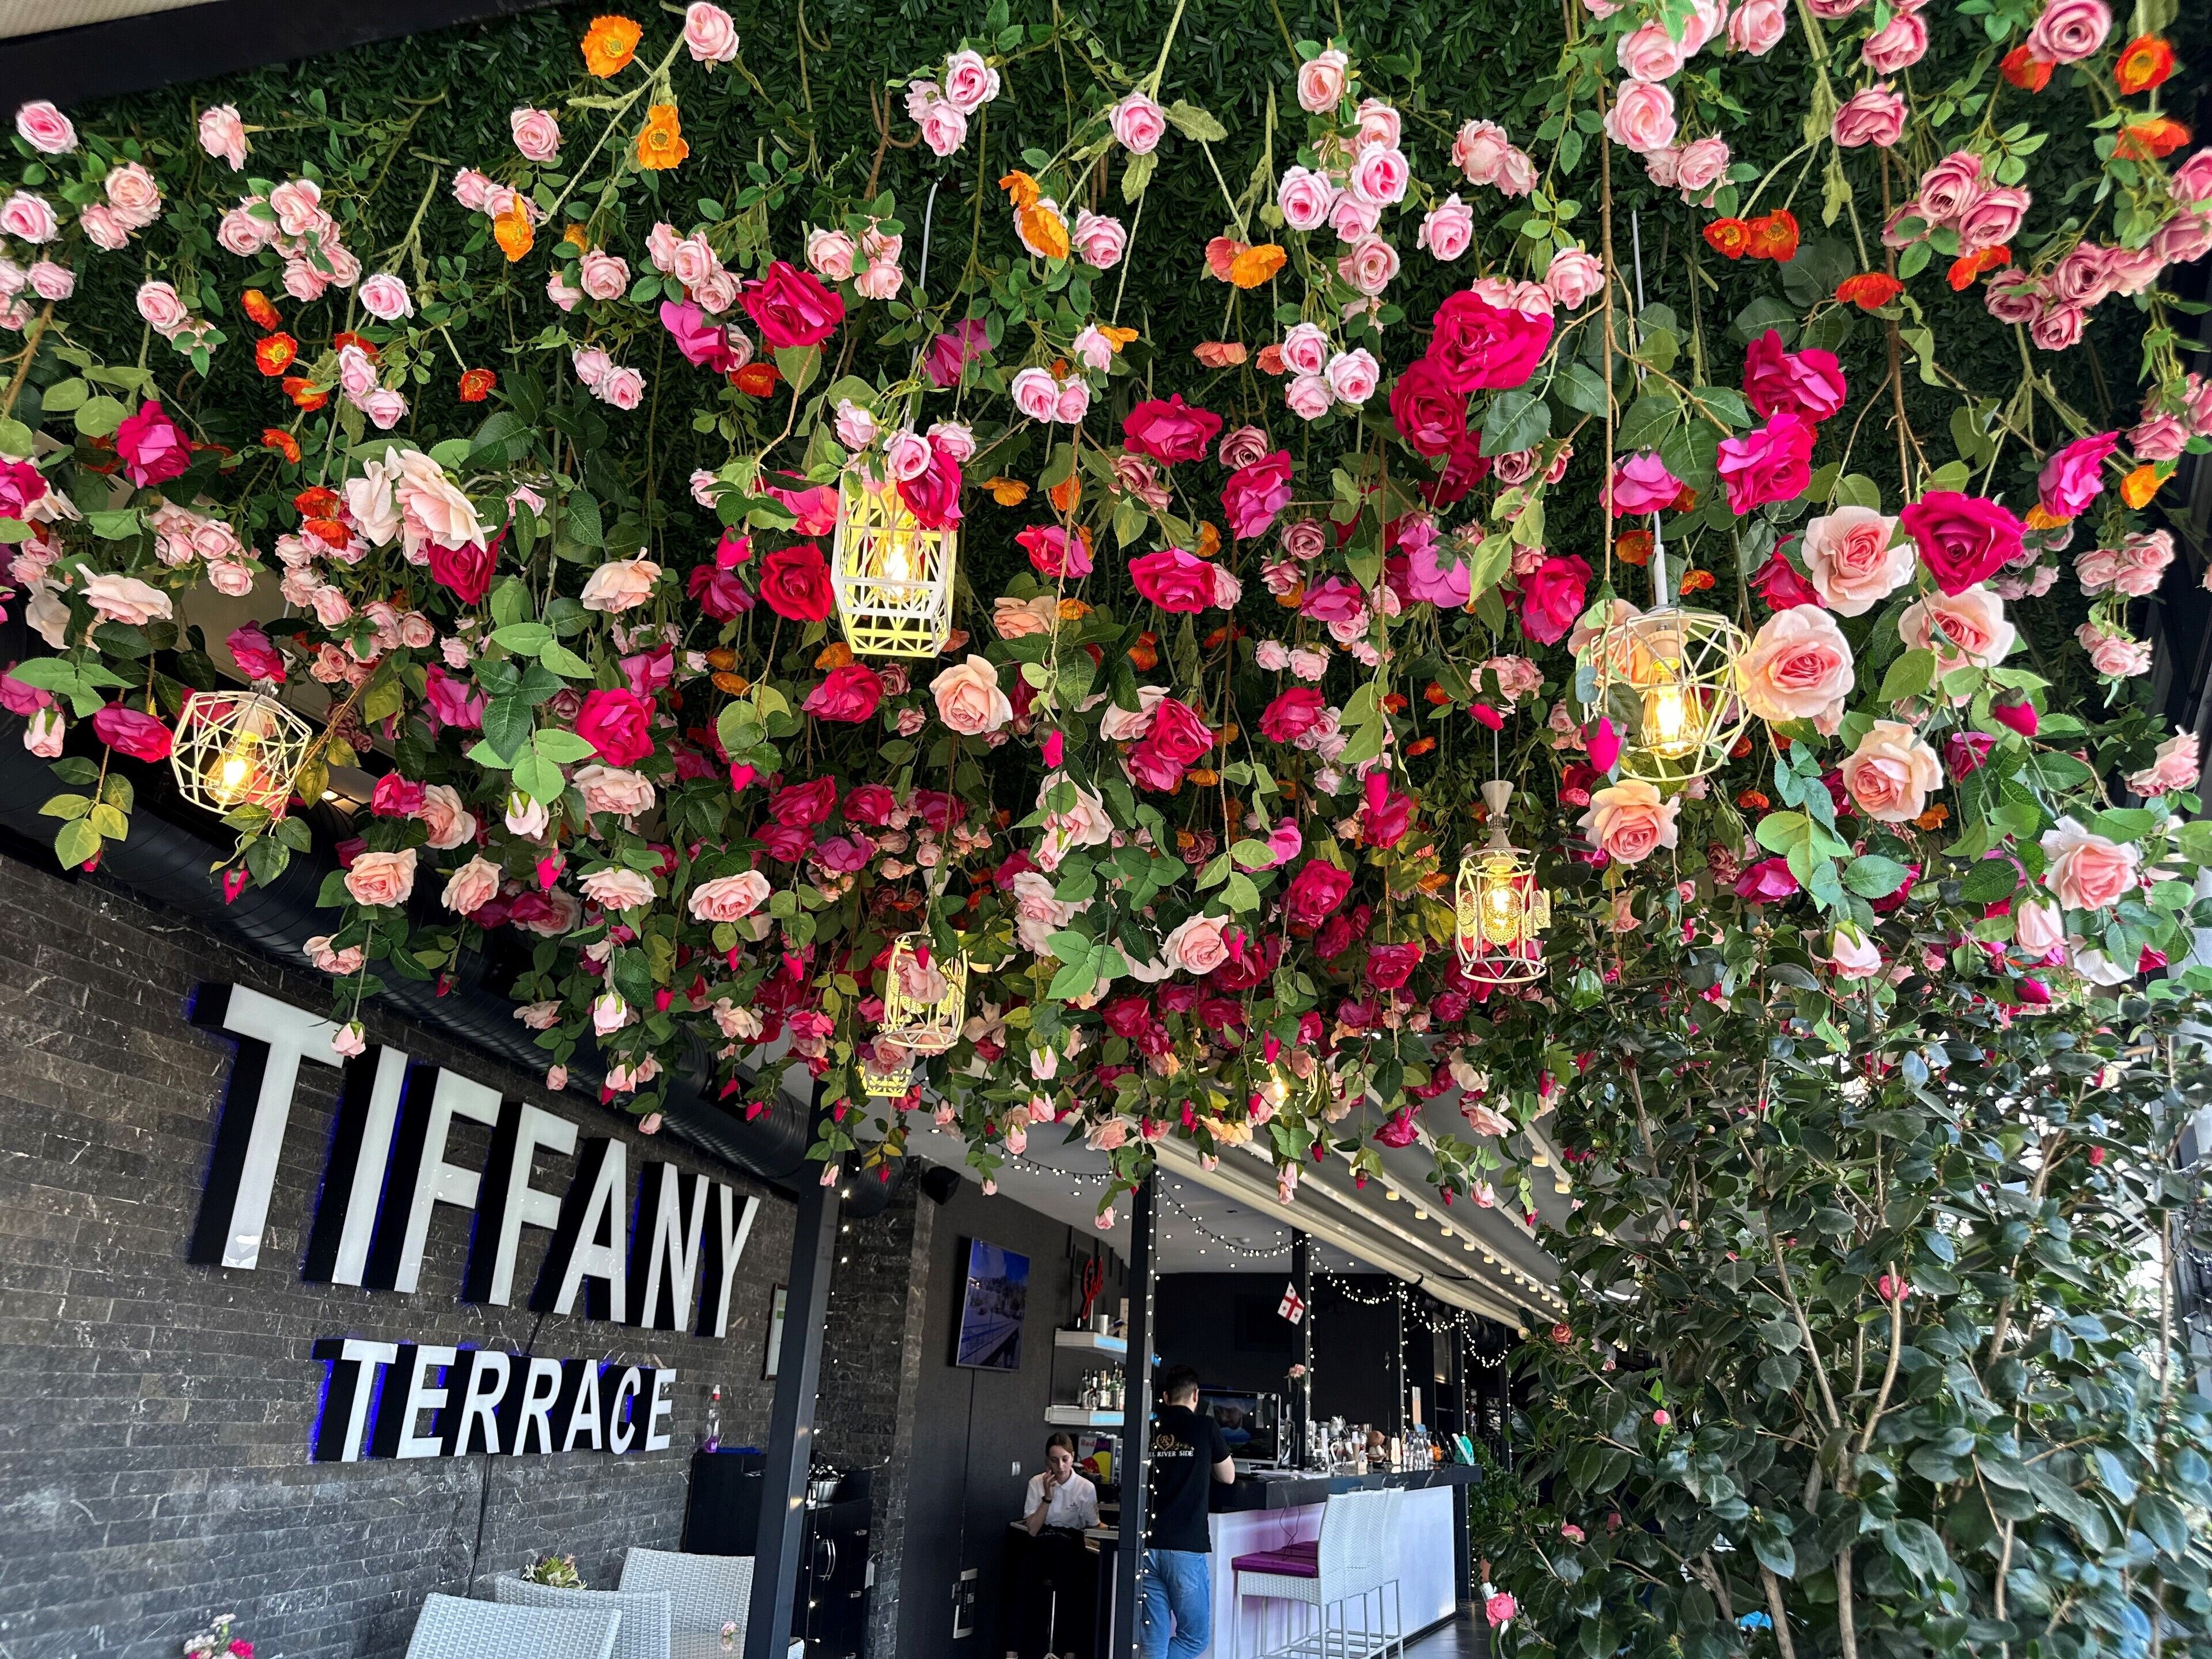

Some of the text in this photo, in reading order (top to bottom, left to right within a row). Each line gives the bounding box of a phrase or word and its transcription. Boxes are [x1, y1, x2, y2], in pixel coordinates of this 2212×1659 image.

[223, 982, 761, 1339] TIFFANY
[341, 1338, 677, 1463] TERRACE
[1081, 1439, 1095, 1448] Red
